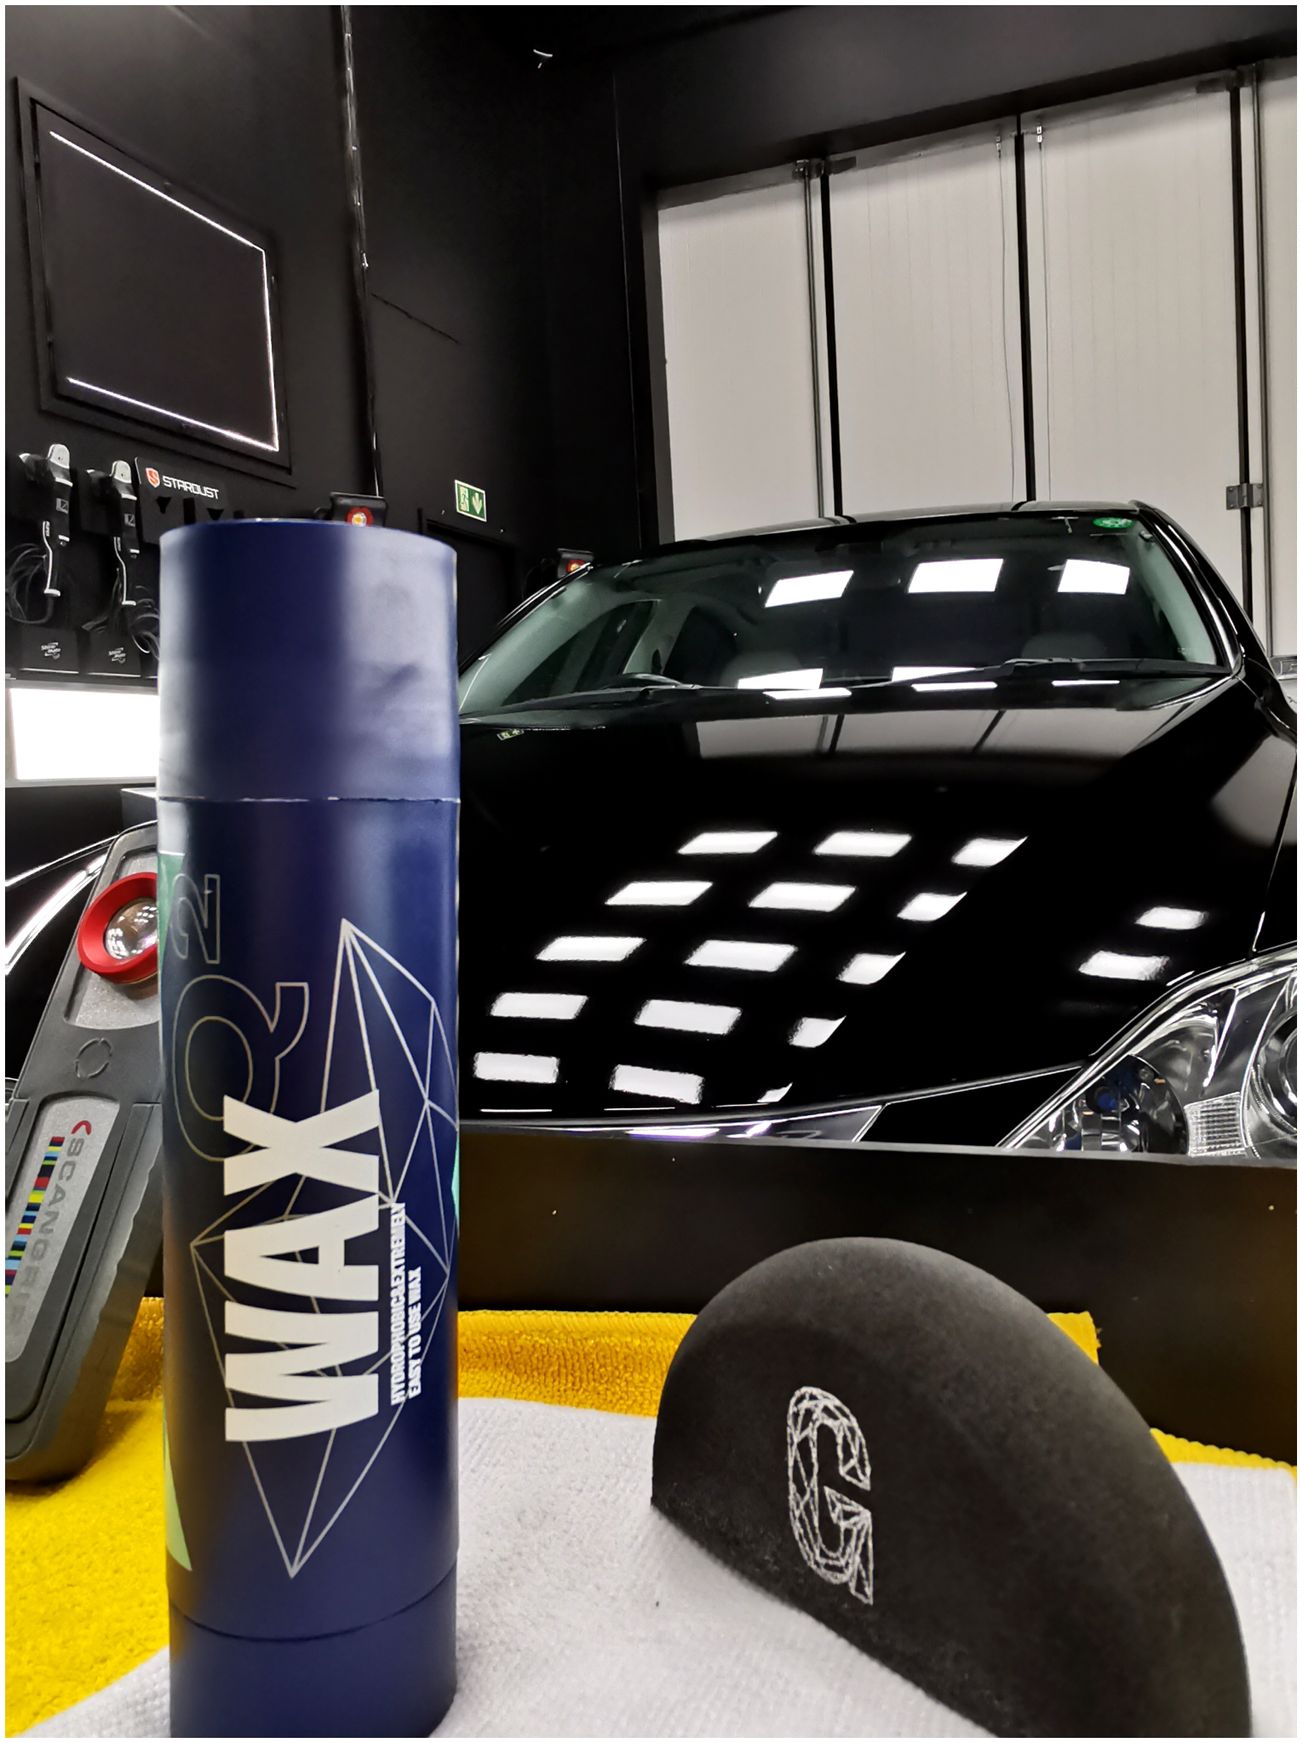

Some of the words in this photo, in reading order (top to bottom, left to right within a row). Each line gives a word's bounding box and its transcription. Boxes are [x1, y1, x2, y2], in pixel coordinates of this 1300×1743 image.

[162, 474, 219, 499] STARDUST
[223, 1089, 379, 1441] WAX
[408, 1266, 421, 1306] WAX
[408, 1302, 421, 1335] USE
[408, 1334, 421, 1359] TO
[408, 1359, 421, 1399] EASY
[787, 1387, 873, 1605] G
